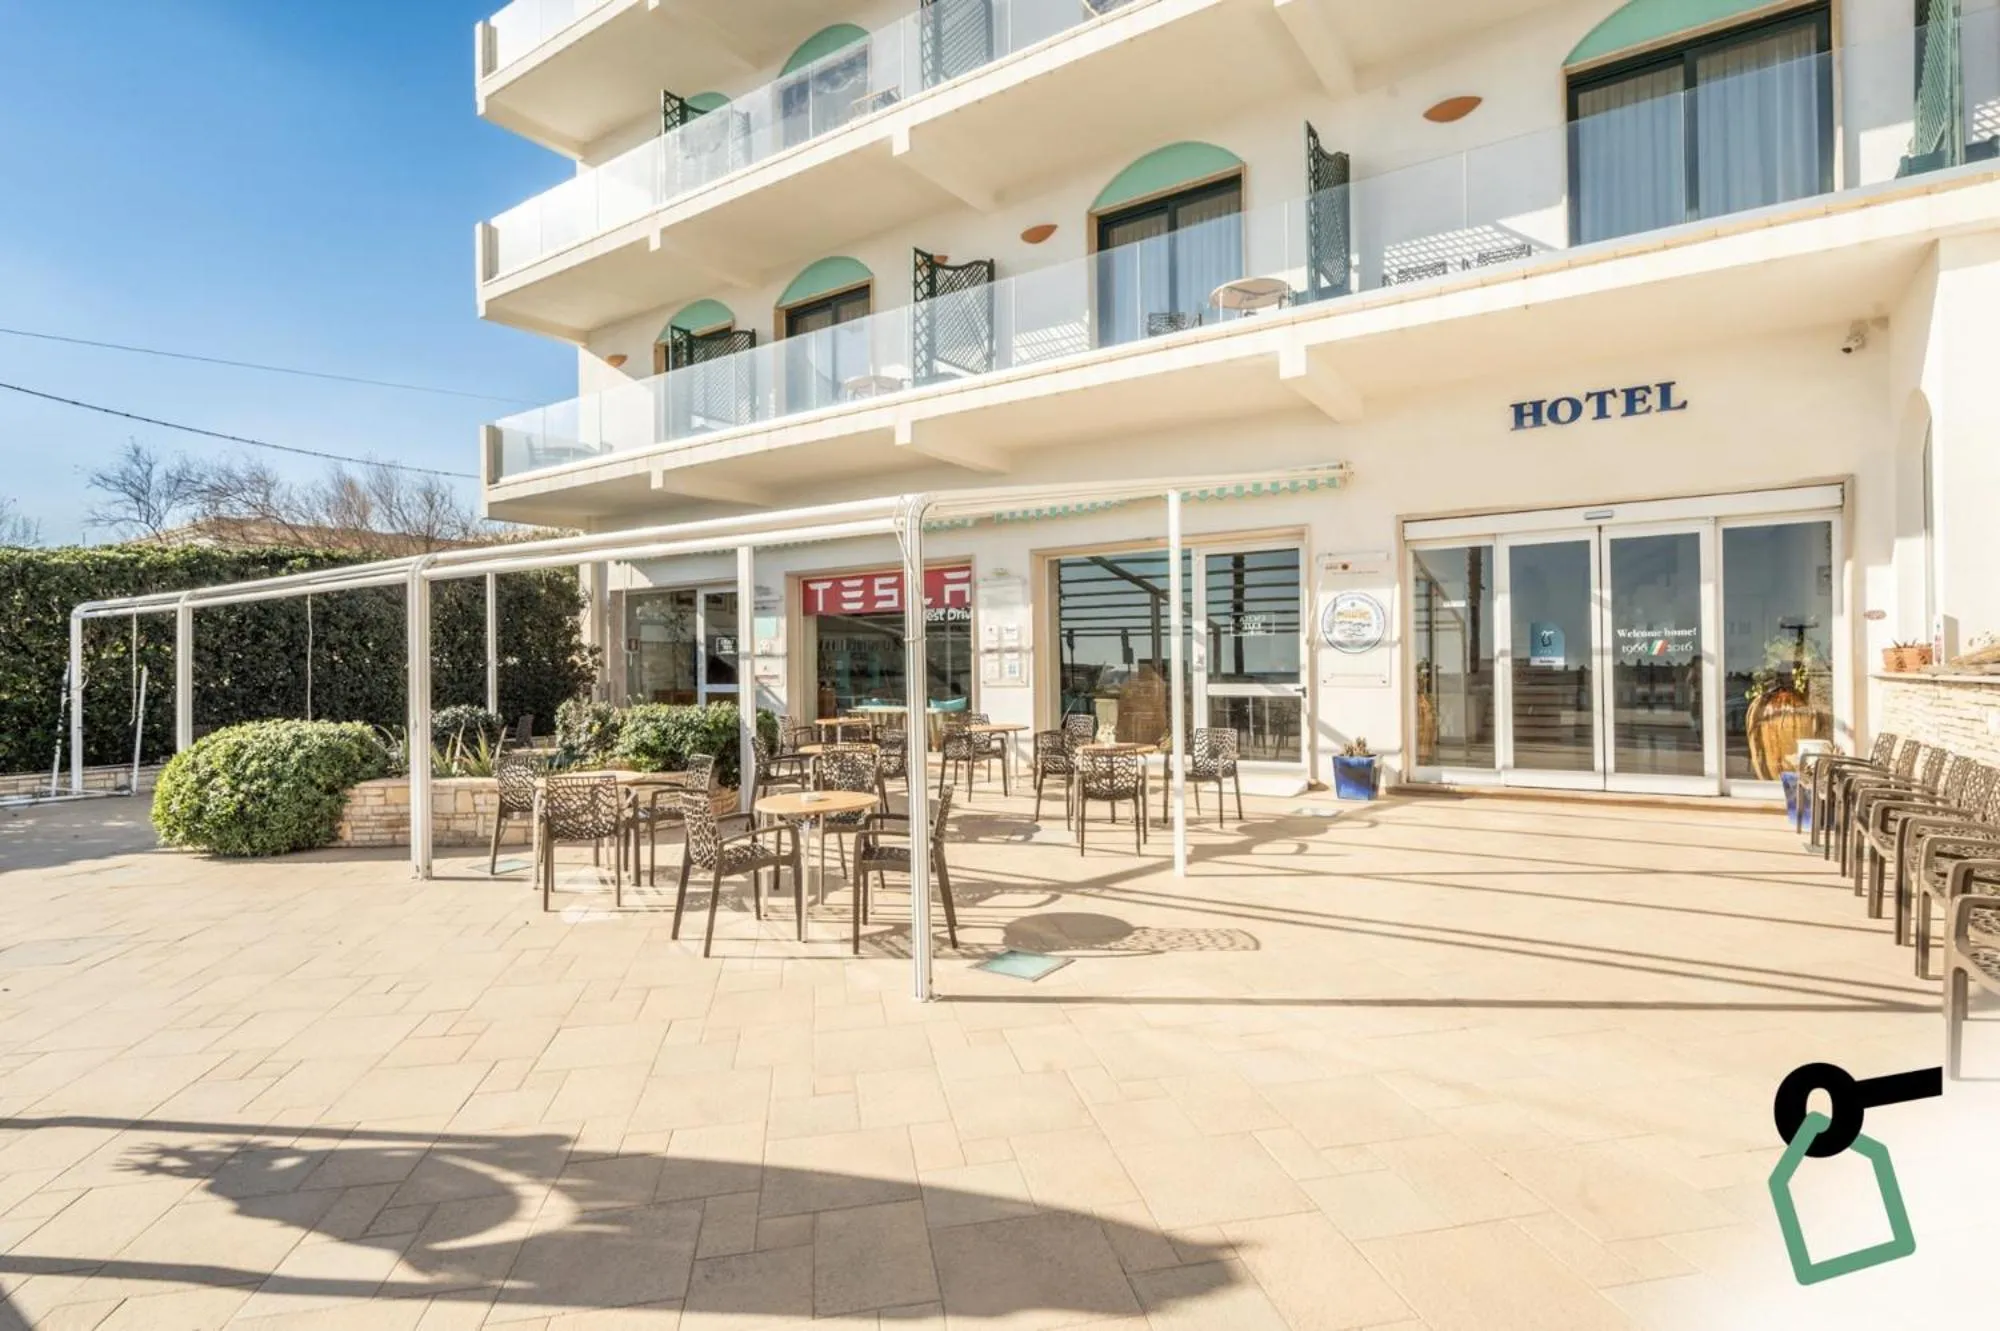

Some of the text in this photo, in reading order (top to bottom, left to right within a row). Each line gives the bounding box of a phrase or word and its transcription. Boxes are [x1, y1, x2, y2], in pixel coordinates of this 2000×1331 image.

[1510, 381, 1687, 431] HOTEL
[808, 571, 971, 612] TESA
[948, 607, 971, 621] Driv
[1621, 641, 1693, 655] 1966 2016
